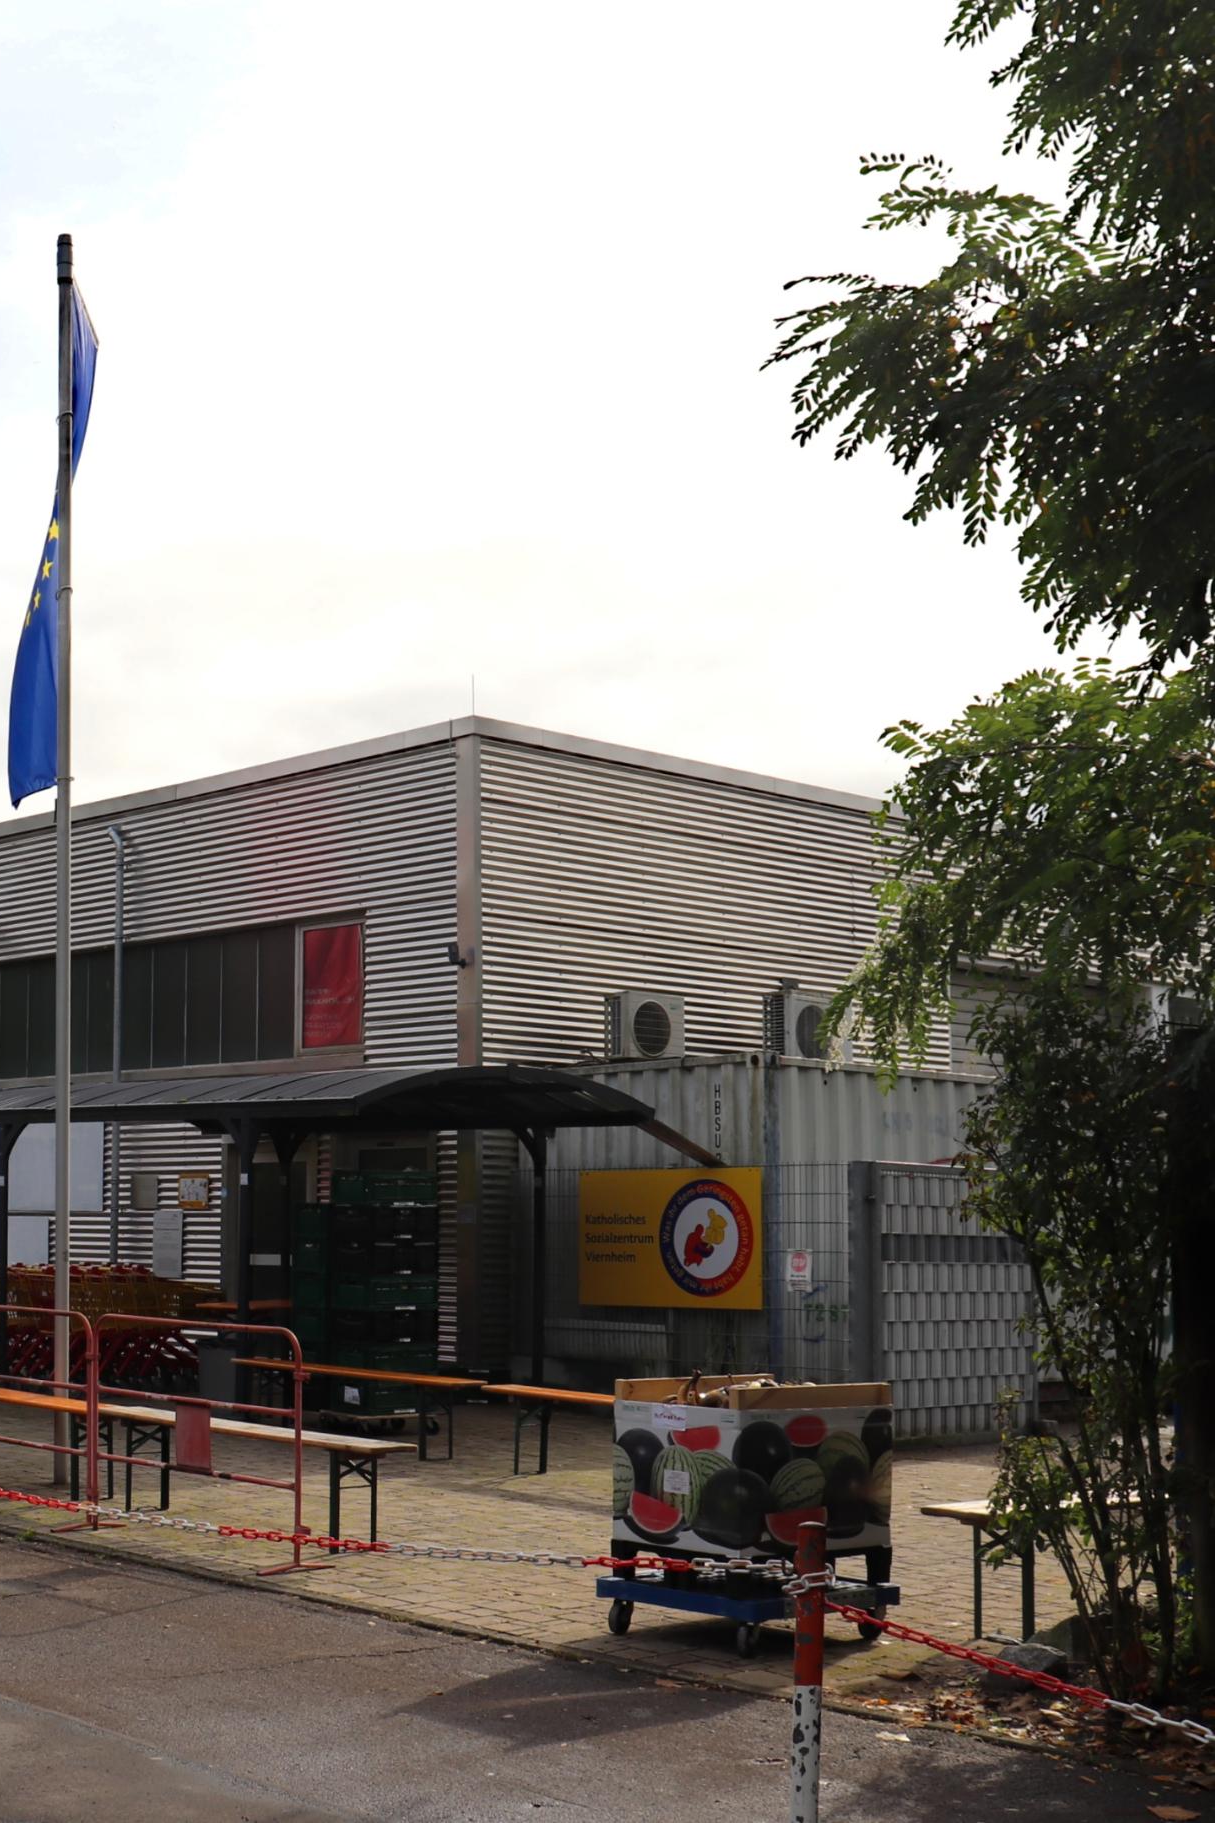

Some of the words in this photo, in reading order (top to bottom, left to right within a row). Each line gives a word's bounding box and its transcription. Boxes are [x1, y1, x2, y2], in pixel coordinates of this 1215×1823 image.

[696, 1183, 742, 1213] Geringsten
[585, 1213, 647, 1226] Katholisches
[585, 1232, 655, 1245] Sozialzentrum
[585, 1251, 637, 1264] Viernheim
